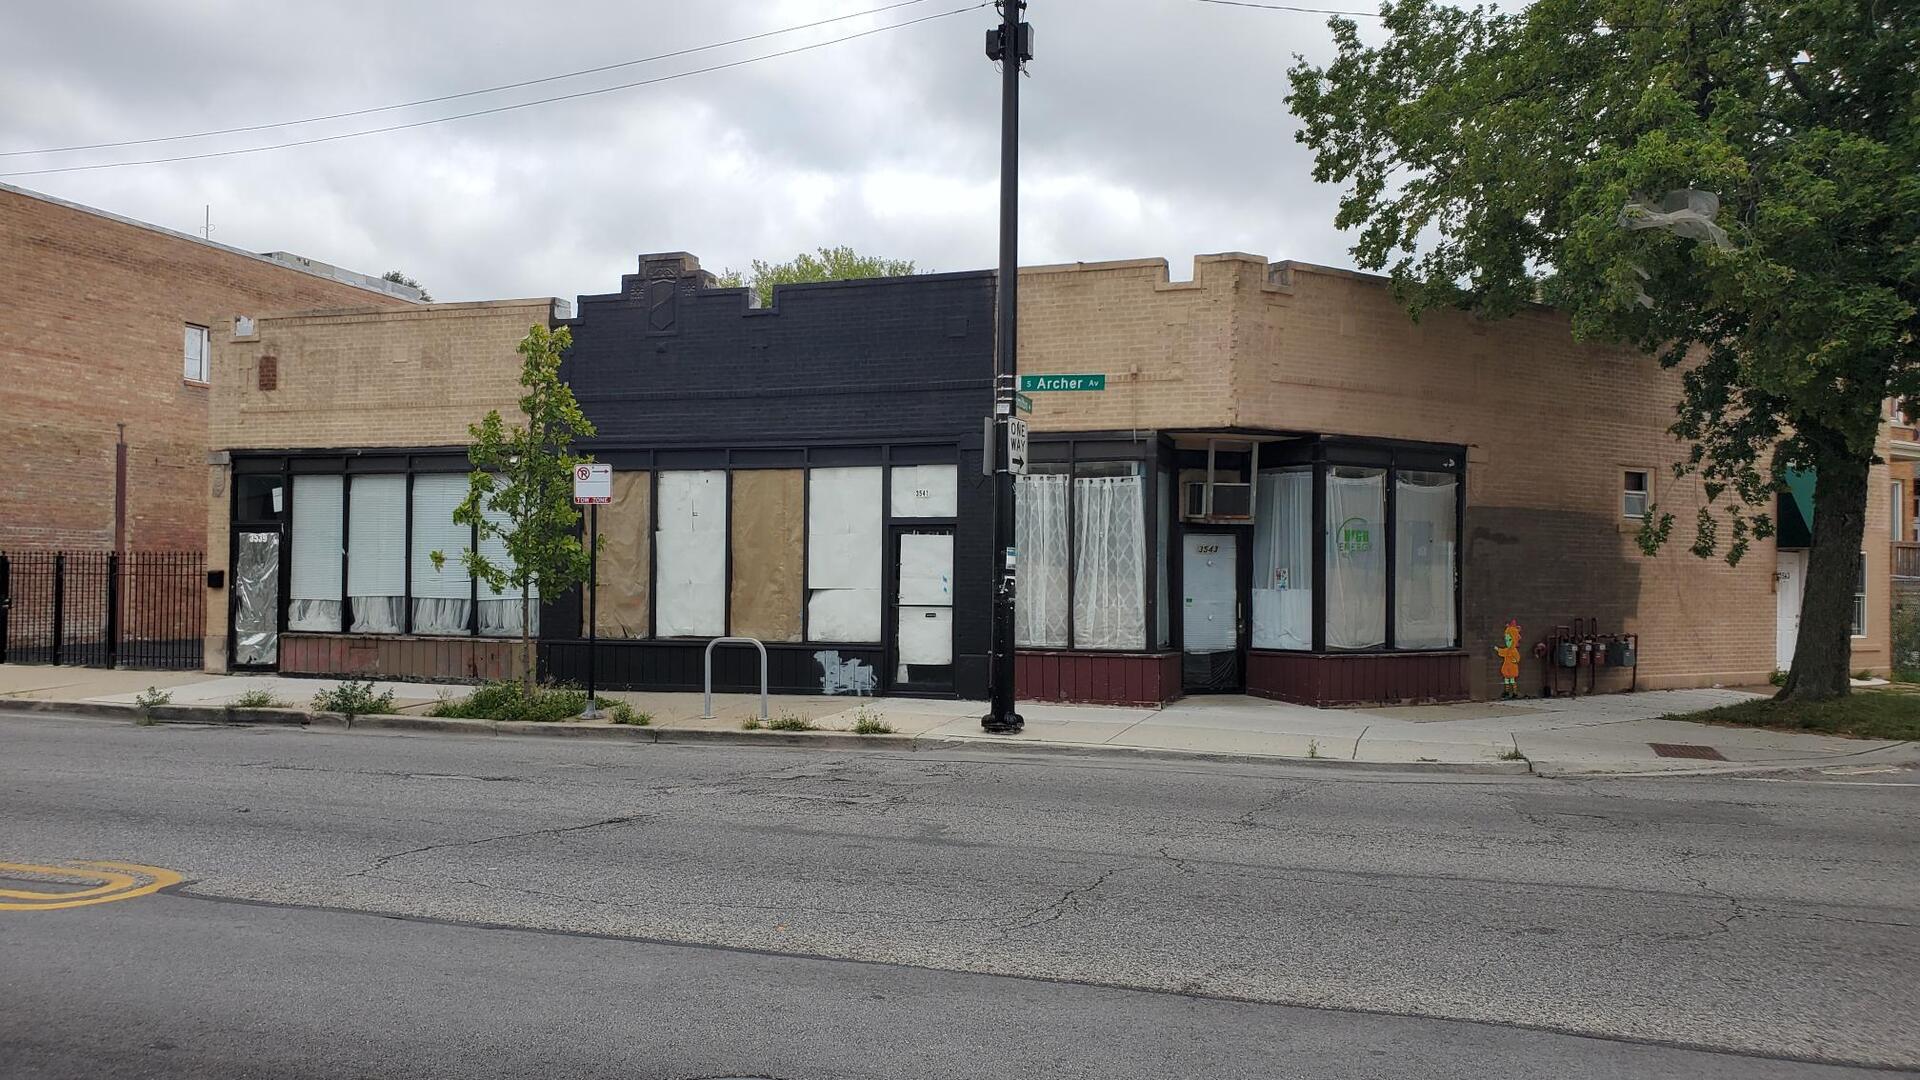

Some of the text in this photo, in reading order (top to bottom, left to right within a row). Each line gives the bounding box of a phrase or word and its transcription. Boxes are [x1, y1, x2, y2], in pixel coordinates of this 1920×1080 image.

[1037, 378, 1083, 389] Archer
[1010, 422, 1026, 438] ONE
[1010, 438, 1026, 453] WAY
[1198, 545, 1219, 553] 3543
